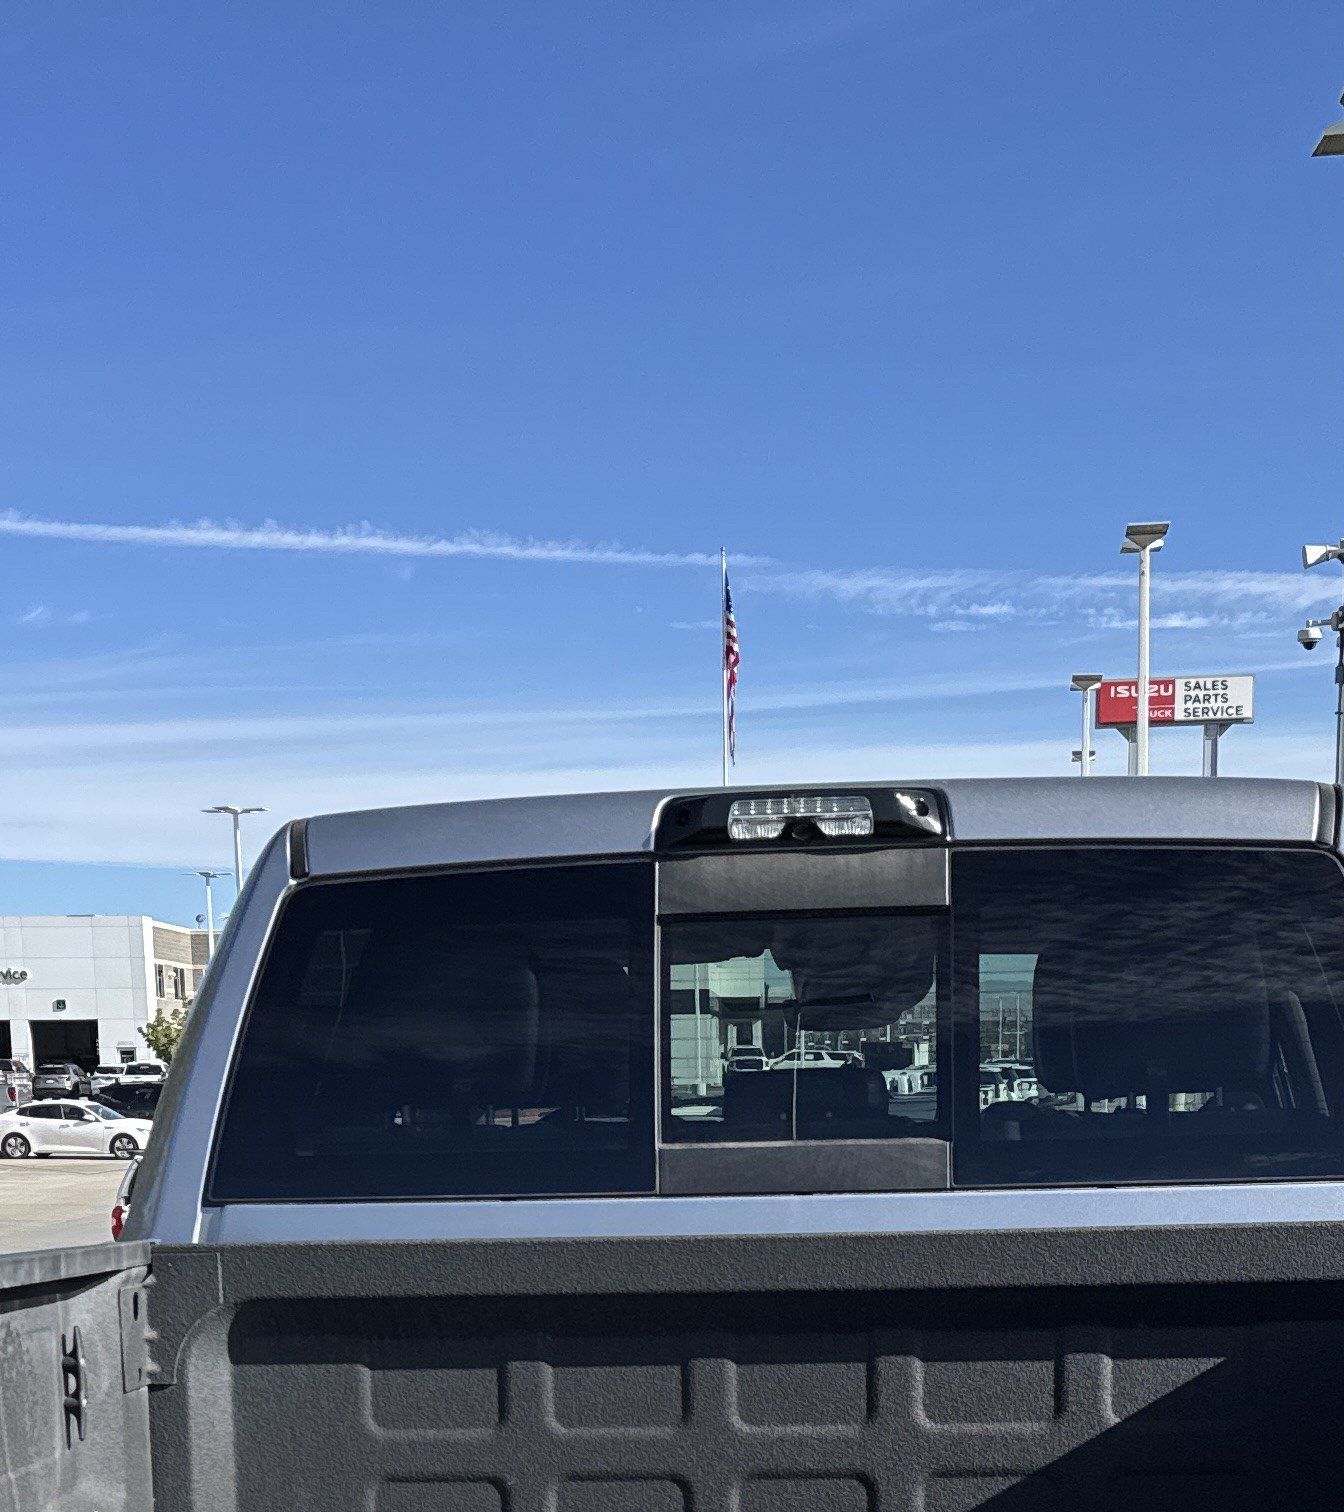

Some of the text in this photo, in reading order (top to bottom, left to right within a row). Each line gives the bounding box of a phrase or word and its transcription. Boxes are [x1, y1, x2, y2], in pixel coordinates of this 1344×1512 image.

[1110, 684, 1173, 698] ISUZU
[1184, 680, 1229, 691] SALES
[1184, 693, 1229, 705] PARTS
[1184, 705, 1244, 718] SERVICE
